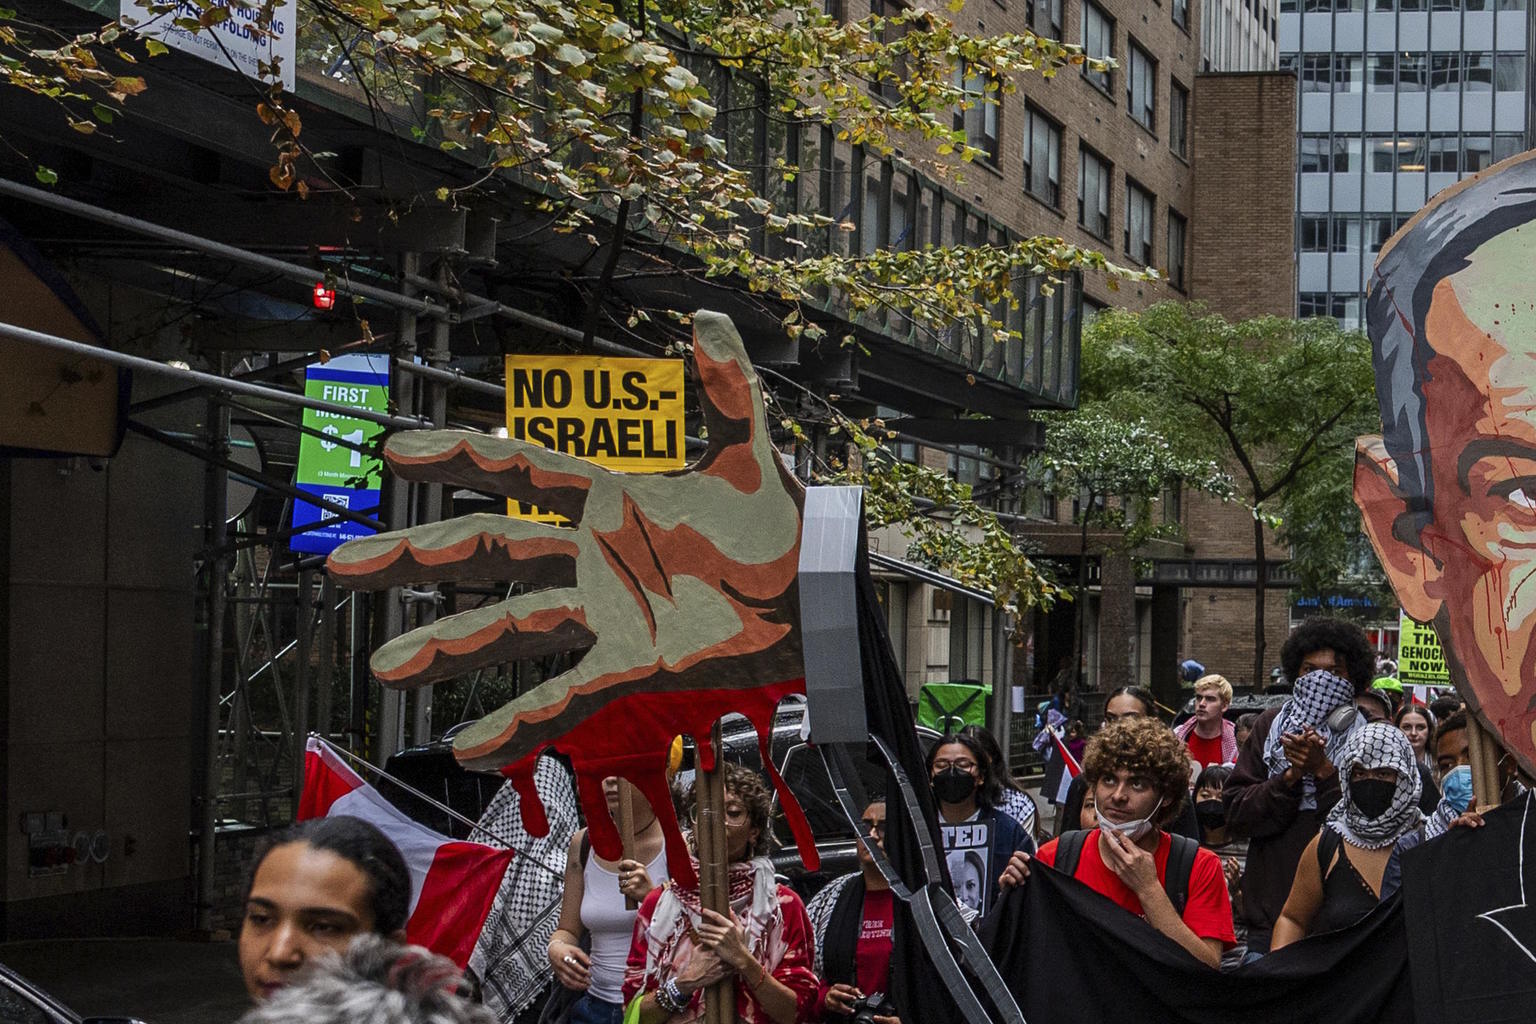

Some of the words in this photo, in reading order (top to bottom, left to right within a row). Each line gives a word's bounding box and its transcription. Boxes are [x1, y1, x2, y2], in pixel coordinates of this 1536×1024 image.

[237, 6, 285, 34] HOISNG
[323, 384, 369, 404] FIRST
[513, 368, 573, 409] NO
[583, 370, 678, 412] U.S.-
[514, 416, 678, 460] ISRAELI
[1401, 646, 1444, 661] GENOCI
[1409, 660, 1449, 673] NOW!
